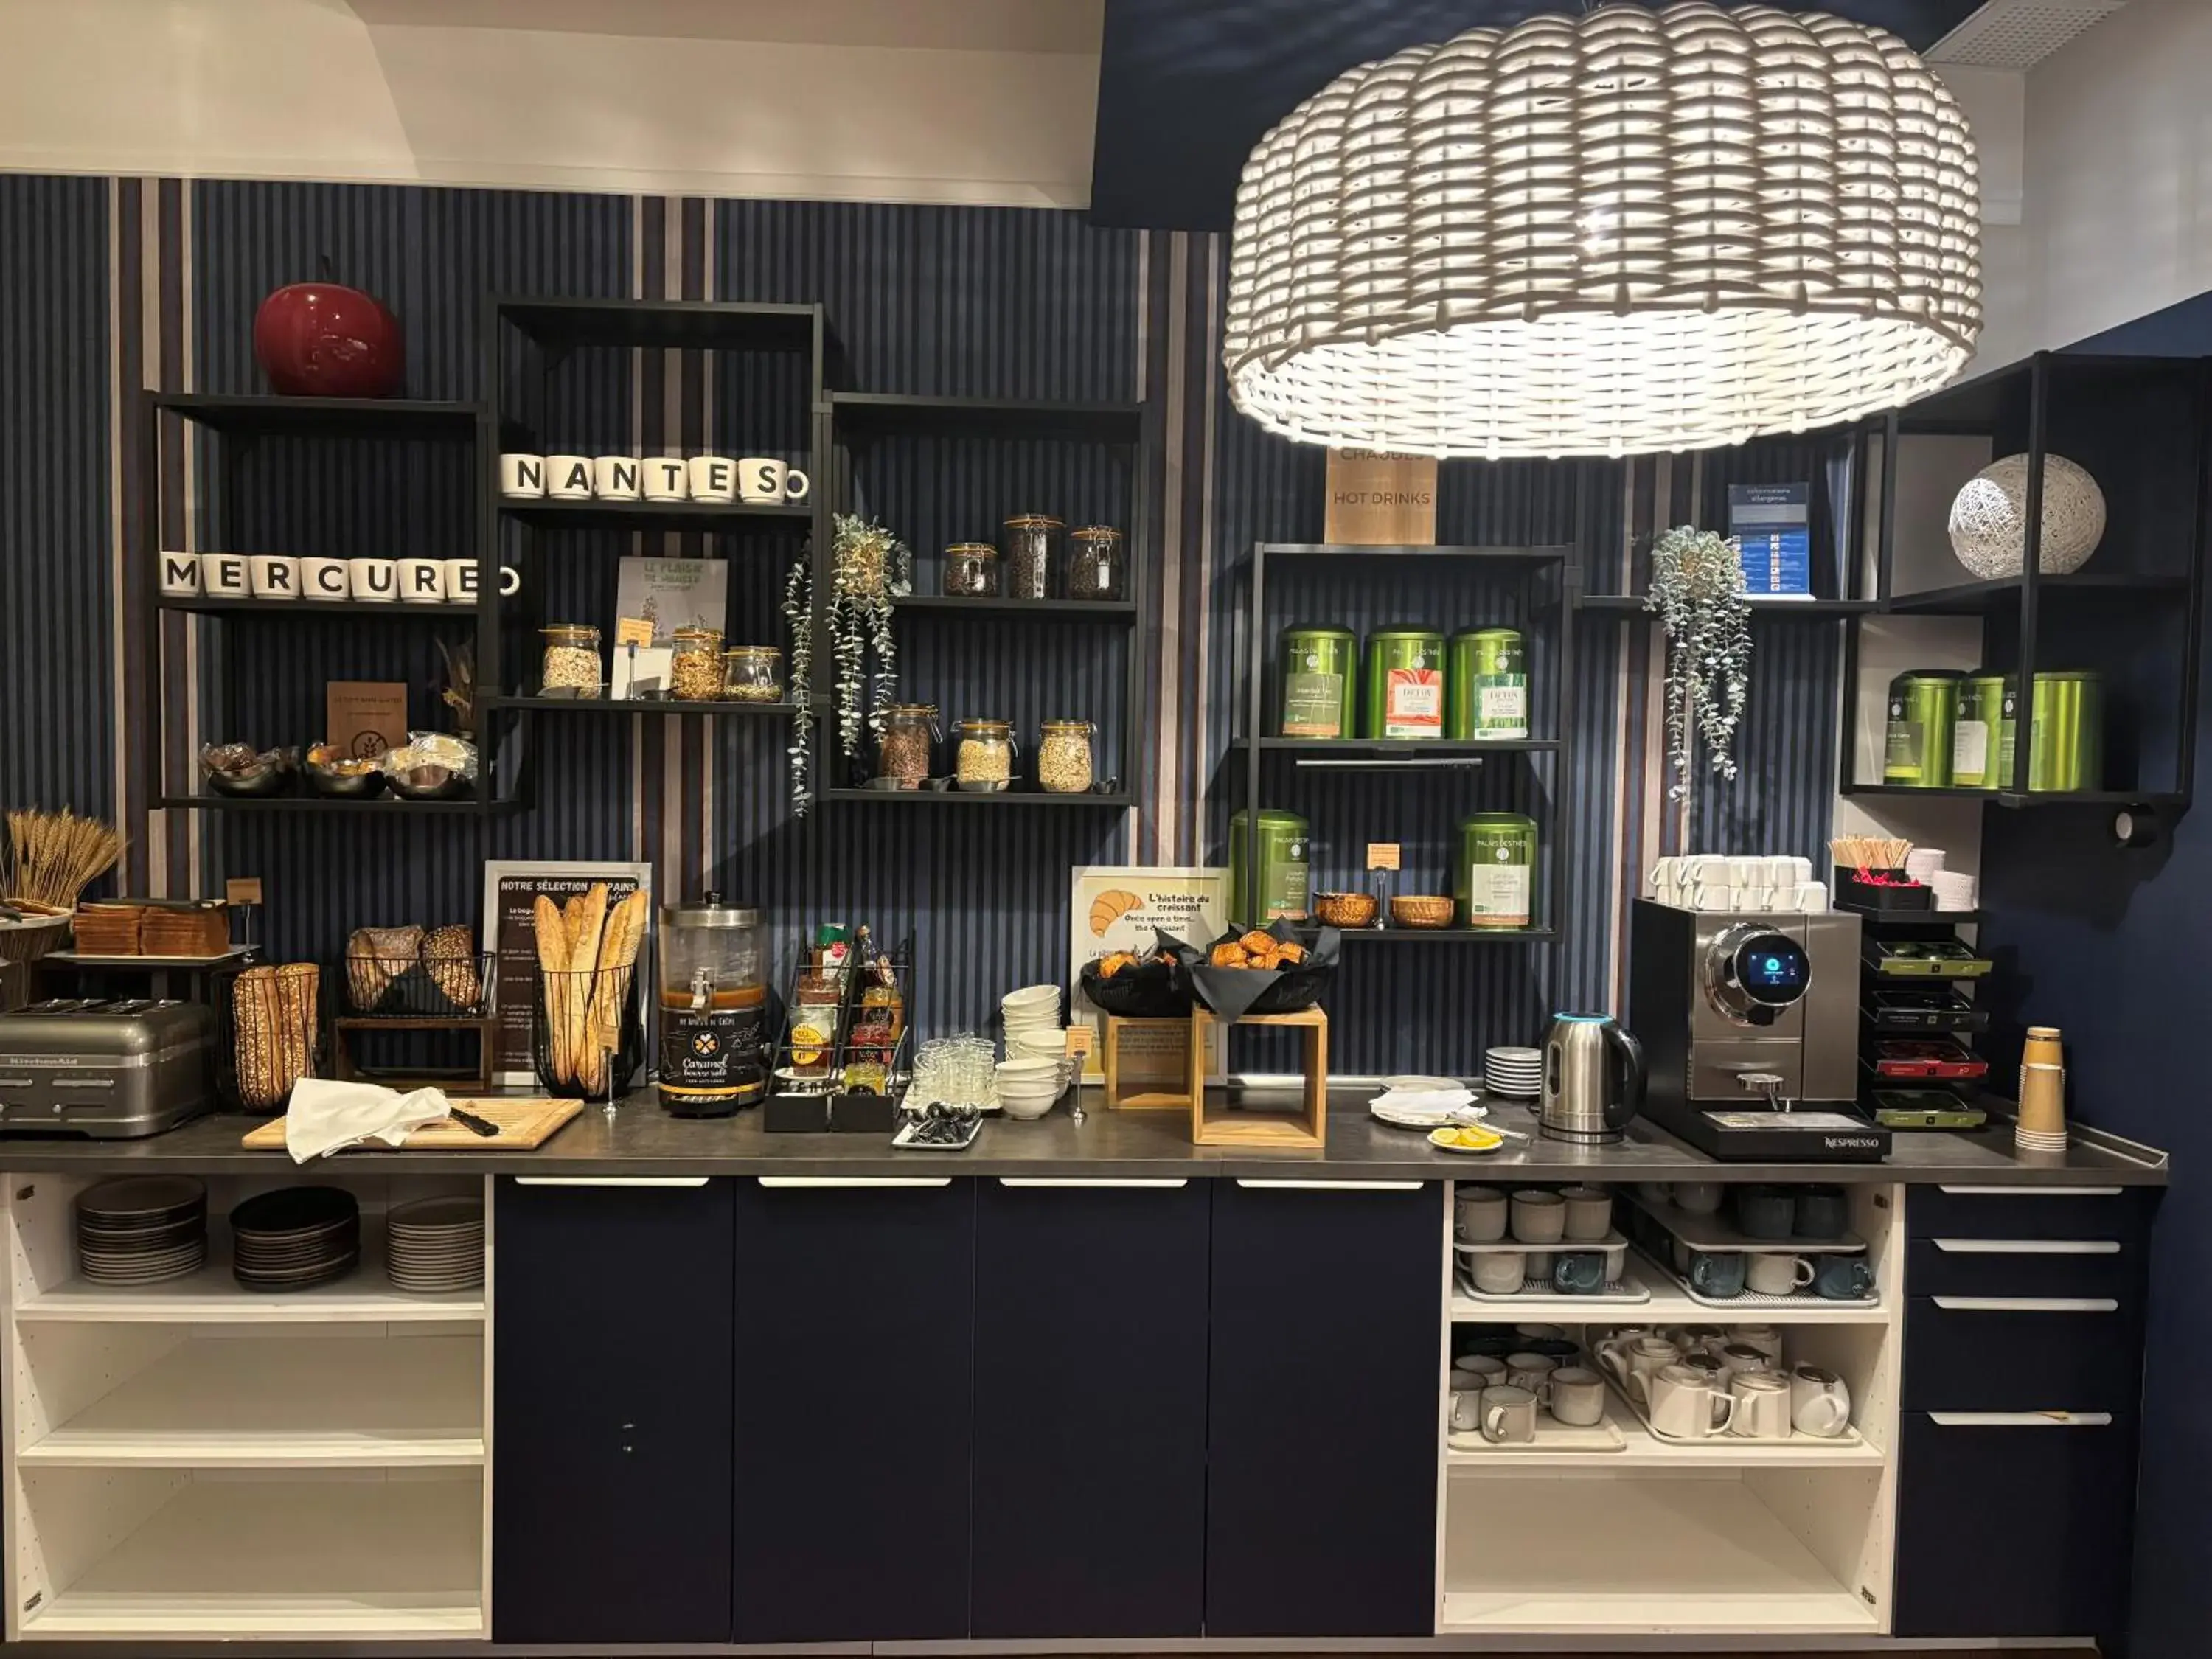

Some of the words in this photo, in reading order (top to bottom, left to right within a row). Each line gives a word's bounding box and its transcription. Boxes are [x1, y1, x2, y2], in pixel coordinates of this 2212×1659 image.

[518, 459, 776, 493] NANTES
[1334, 493, 1367, 504] HOT
[1372, 493, 1430, 505] DRINKS
[167, 558, 478, 592] MERCURE
[501, 881, 533, 891] NOTRE
[536, 879, 588, 891] SÉLECTION
[608, 883, 636, 891] PAINS
[1149, 893, 1195, 903] L'histoire
[1197, 894, 1210, 903] du
[1157, 904, 1201, 912] croissant
[683, 1053, 729, 1068] Caramel
[1824, 1136, 1879, 1149] NESPRESSO
